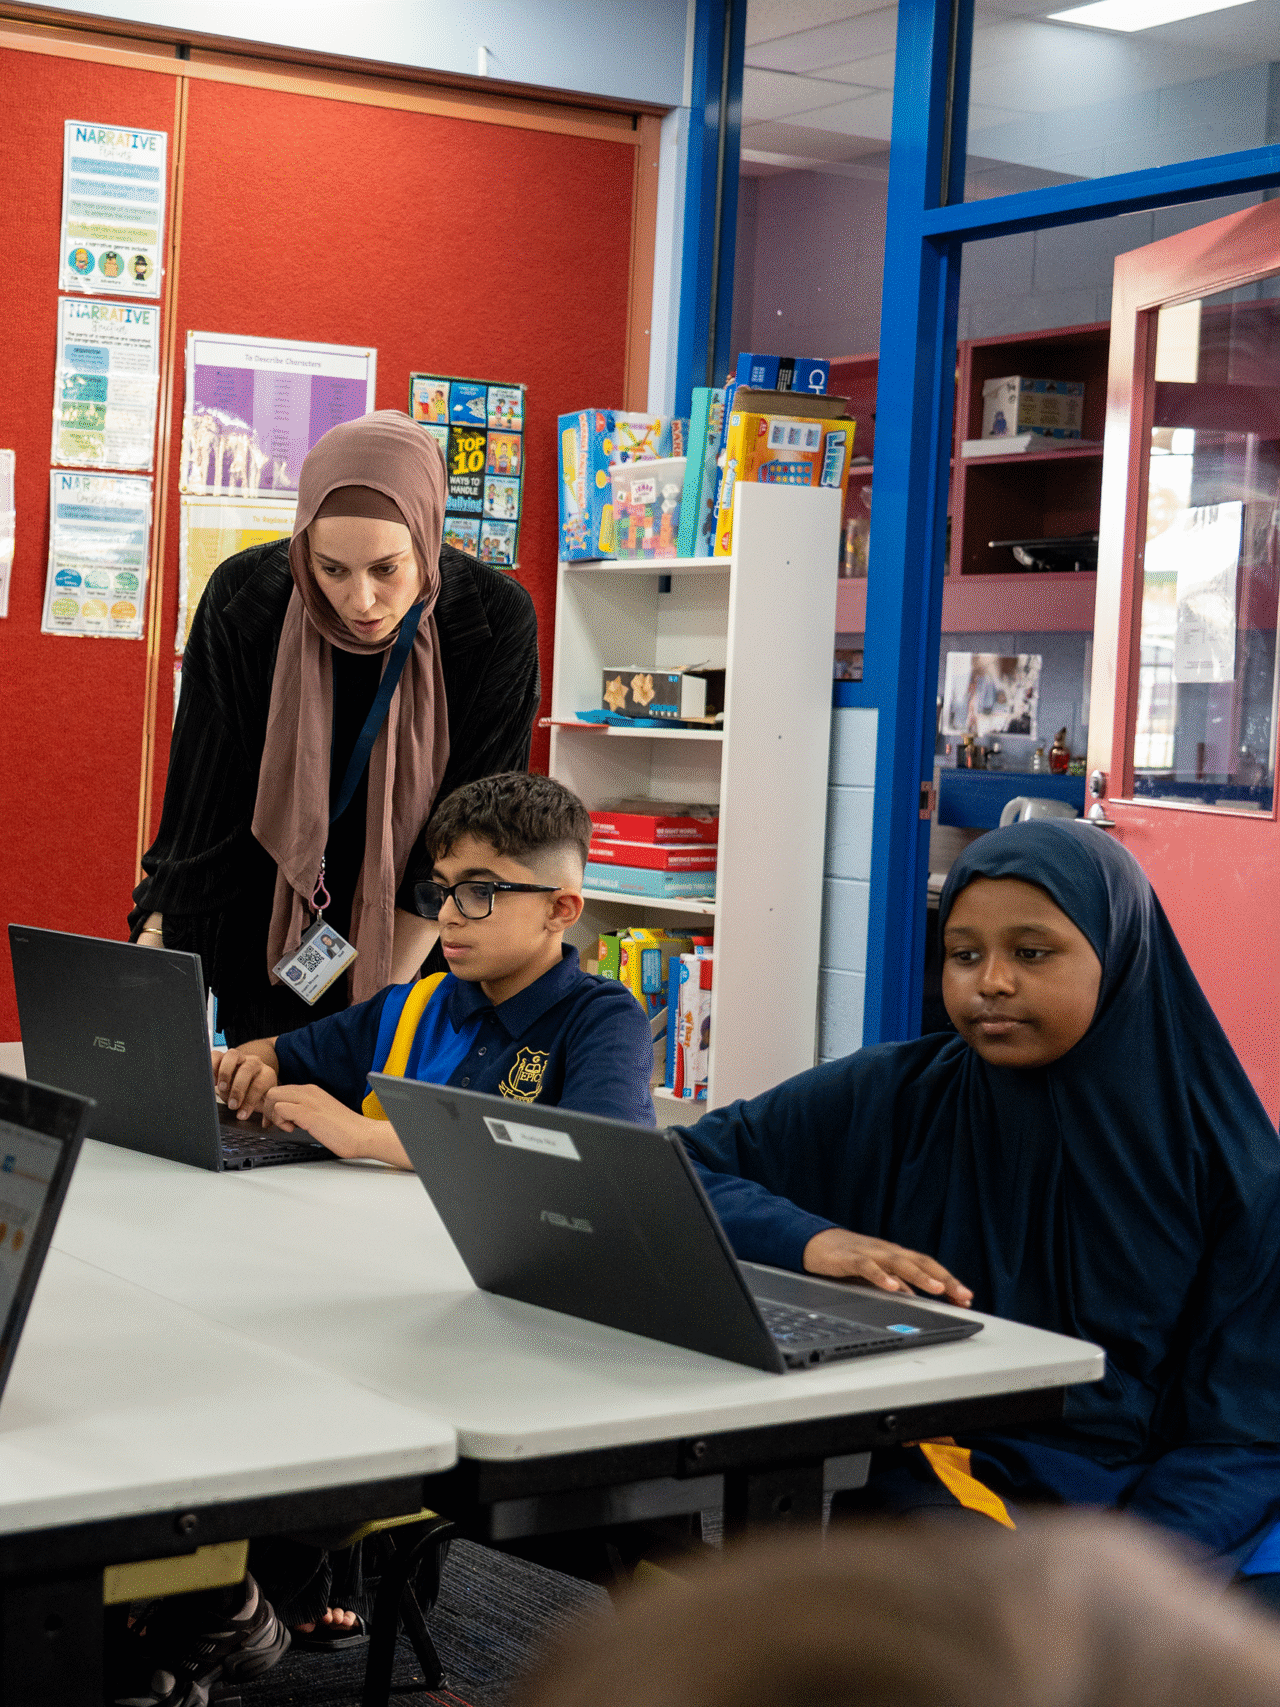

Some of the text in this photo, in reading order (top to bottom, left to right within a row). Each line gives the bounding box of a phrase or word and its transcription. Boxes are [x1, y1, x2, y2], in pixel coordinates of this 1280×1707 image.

[76, 128, 156, 151] NARRATIVE
[255, 355, 283, 363] Describe
[286, 358, 320, 367] Characters
[456, 437, 486, 452] TOP
[453, 451, 484, 475] 10
[450, 476, 480, 486] WAYS TO
[450, 486, 478, 496] HANDLE
[684, 1011, 694, 1047] What
[93, 1036, 126, 1053] ASUS
[520, 1071, 541, 1082] EPIC
[540, 1210, 593, 1233] ASUS
